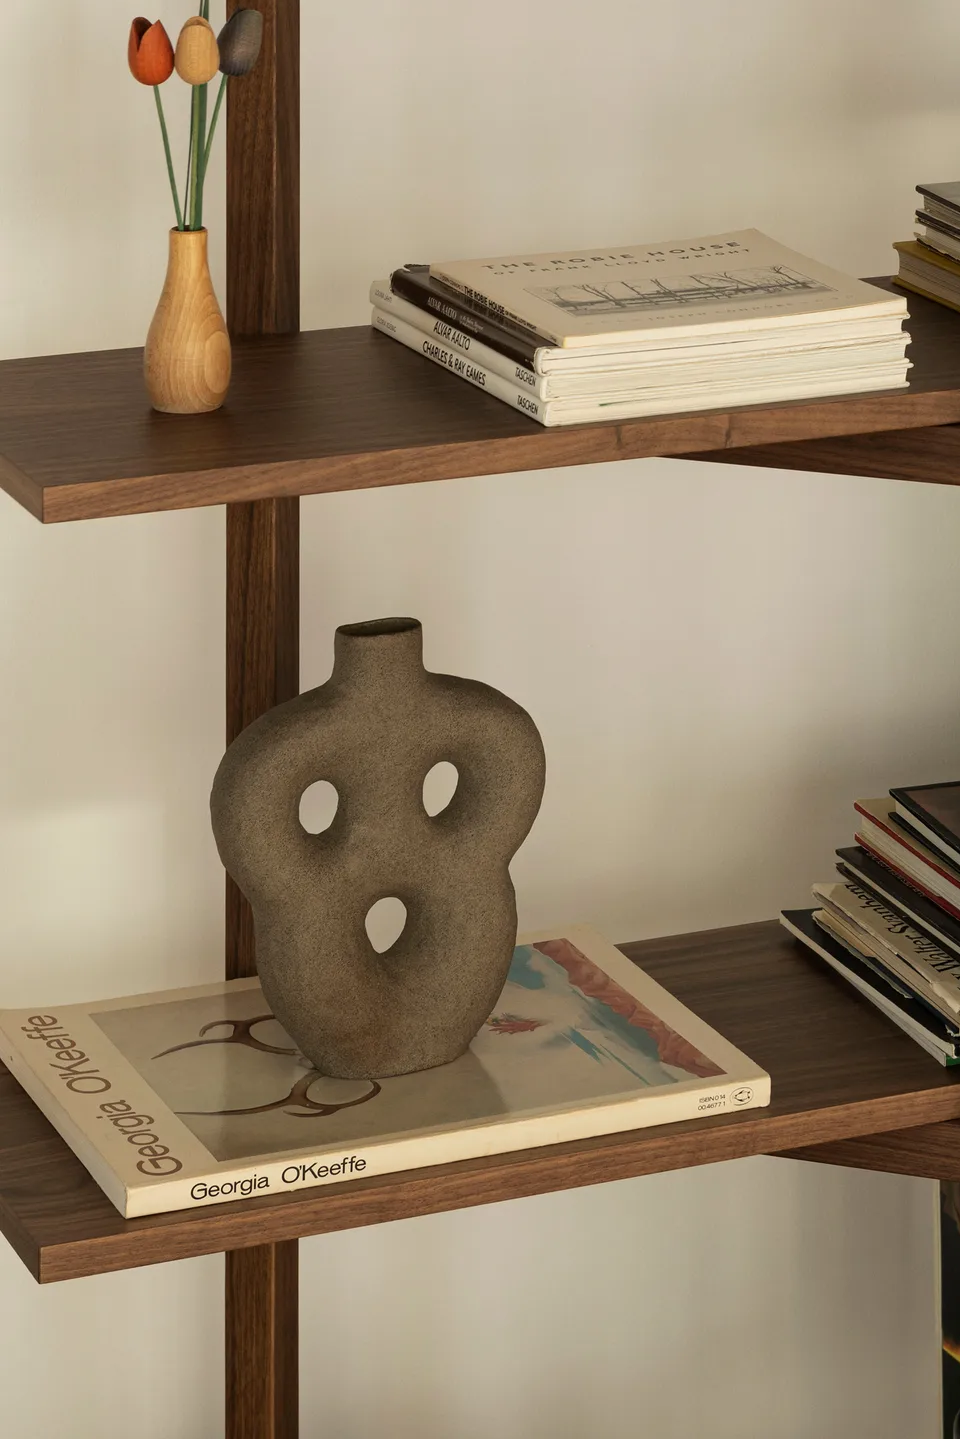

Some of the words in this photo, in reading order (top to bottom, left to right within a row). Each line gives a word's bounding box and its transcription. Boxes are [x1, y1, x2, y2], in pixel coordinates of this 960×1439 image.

[481, 261, 536, 270] THE
[550, 254, 634, 265] ROBIE
[647, 241, 741, 256] HOUSE
[530, 265, 592, 273] FRANK
[604, 259, 666, 267] LLOYD
[678, 249, 750, 260] WRIGHT
[463, 286, 473, 298] THE
[473, 289, 487, 306] ROBIE
[488, 298, 505, 316] HOUSE
[433, 320, 450, 341] ALVAR
[451, 331, 471, 351] AALTO
[515, 367, 536, 387] TASCHEN
[422, 340, 448, 365] CHARLES
[448, 354, 454, 367] &
[454, 358, 465, 374] RAY
[466, 365, 486, 386] EAMES
[517, 395, 538, 415] TASCHEN
[905, 934, 960, 973] Walter
[20, 1013, 112, 1094] O'Keeffe
[97, 1099, 183, 1176] Georgia
[190, 1174, 270, 1200] Georgia
[281, 1155, 367, 1184] O'Keeffe
